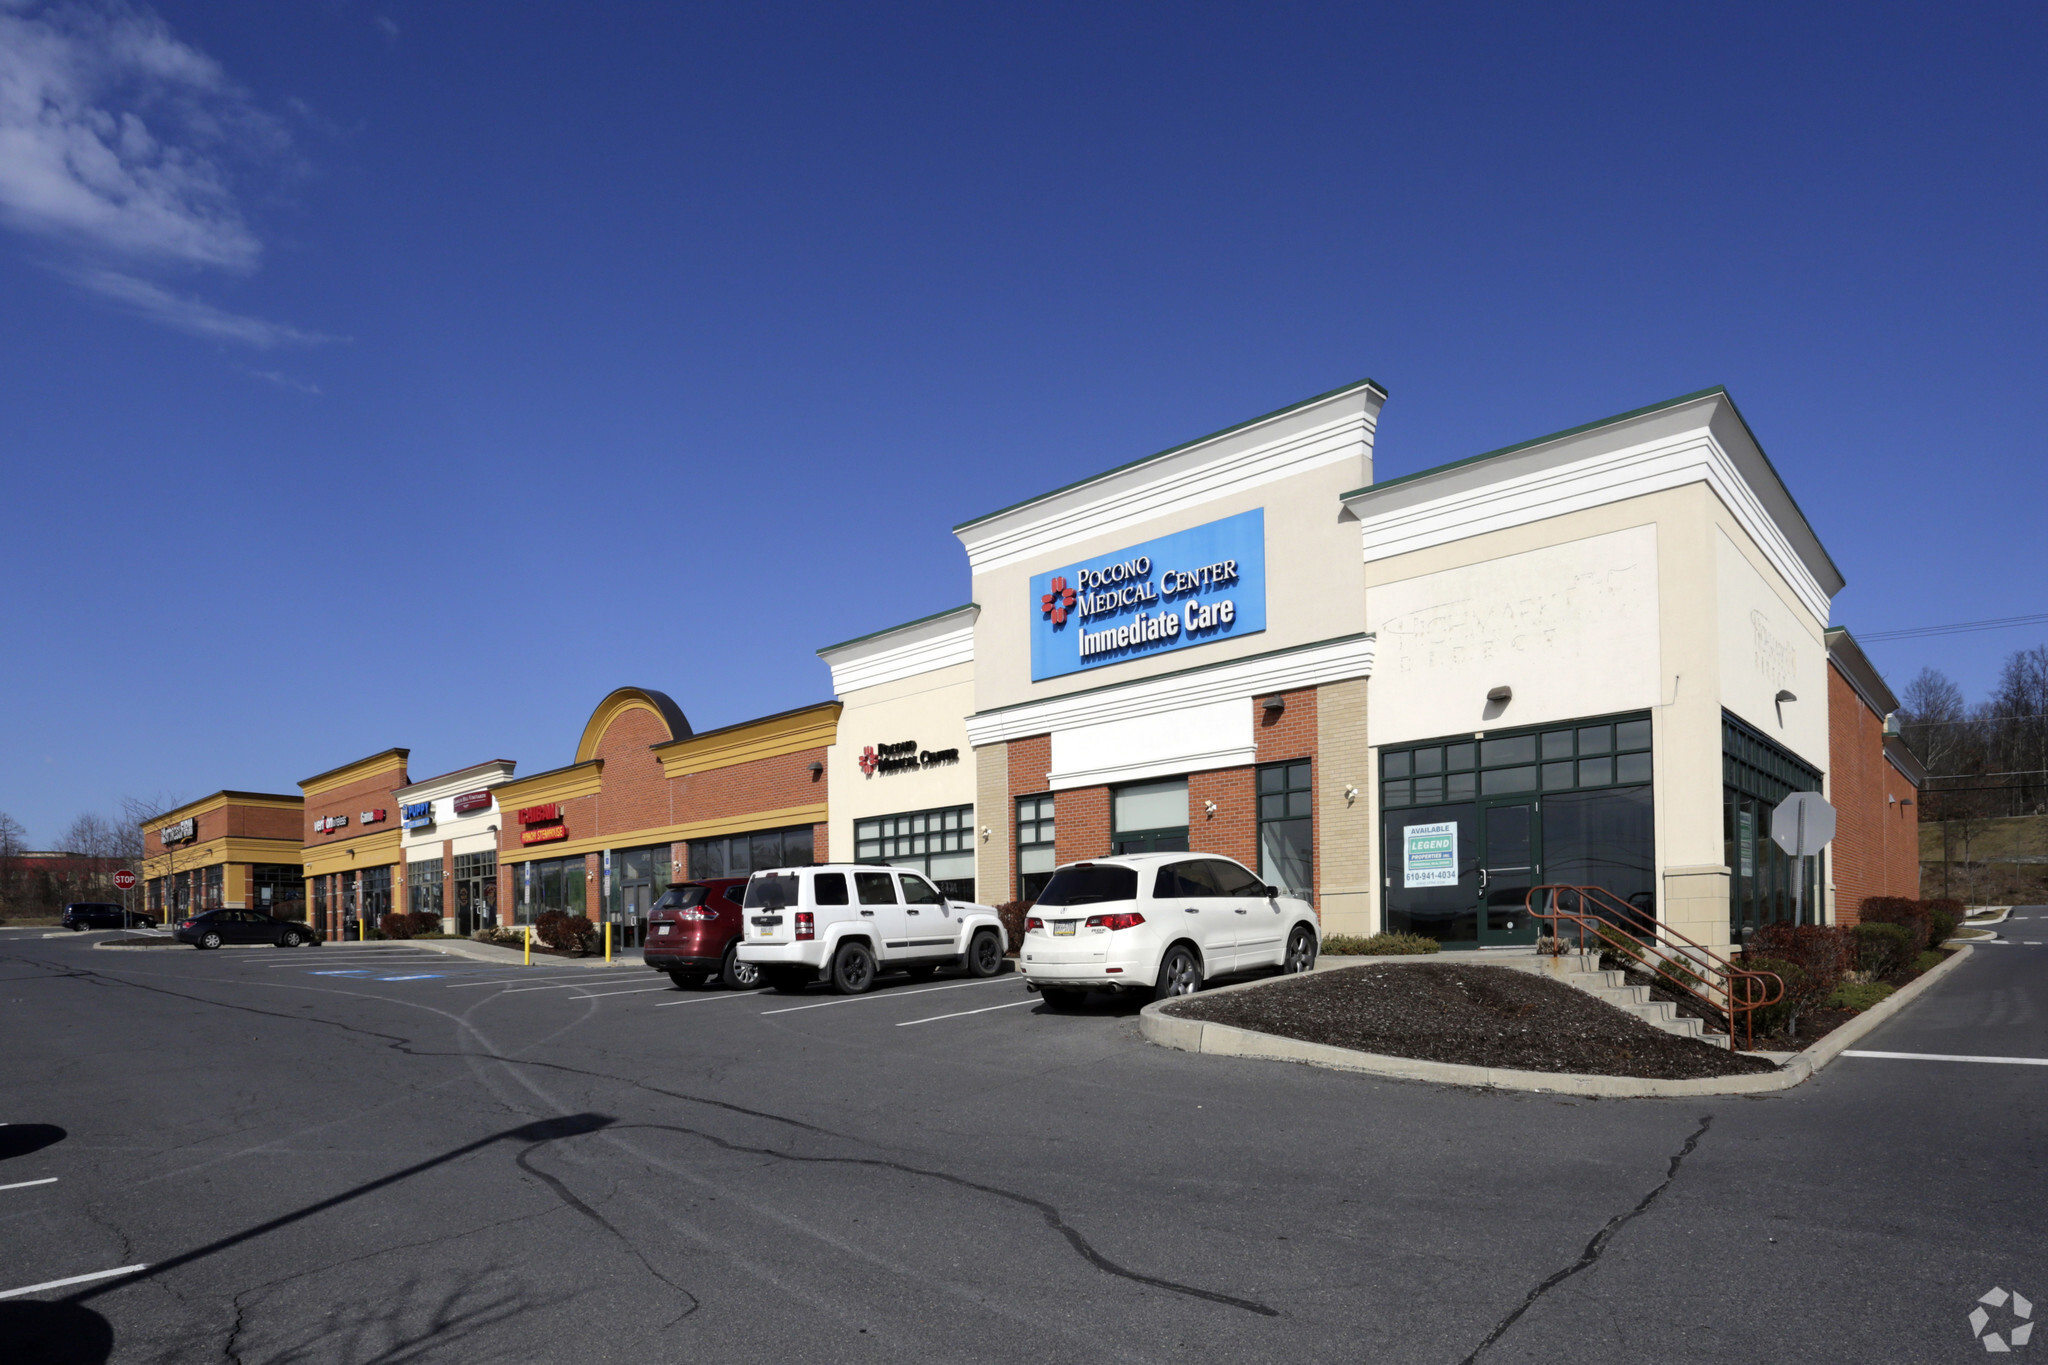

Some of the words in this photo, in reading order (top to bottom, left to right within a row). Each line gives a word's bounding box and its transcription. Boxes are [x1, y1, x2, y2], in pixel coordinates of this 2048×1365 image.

[1077, 556, 1150, 593] POCONO
[1077, 582, 1156, 617] MEDICAL
[1160, 560, 1237, 595] CENTER
[1078, 611, 1179, 656] Immediate
[1184, 600, 1234, 631] Care
[408, 801, 430, 817] PUPPY
[518, 803, 558, 824] ICHIBAN
[1411, 825, 1449, 834] AVAILABLE
[1412, 839, 1450, 851] LEGEND
[115, 876, 135, 884] STOP
[1406, 871, 1456, 881] 610-941-4034
